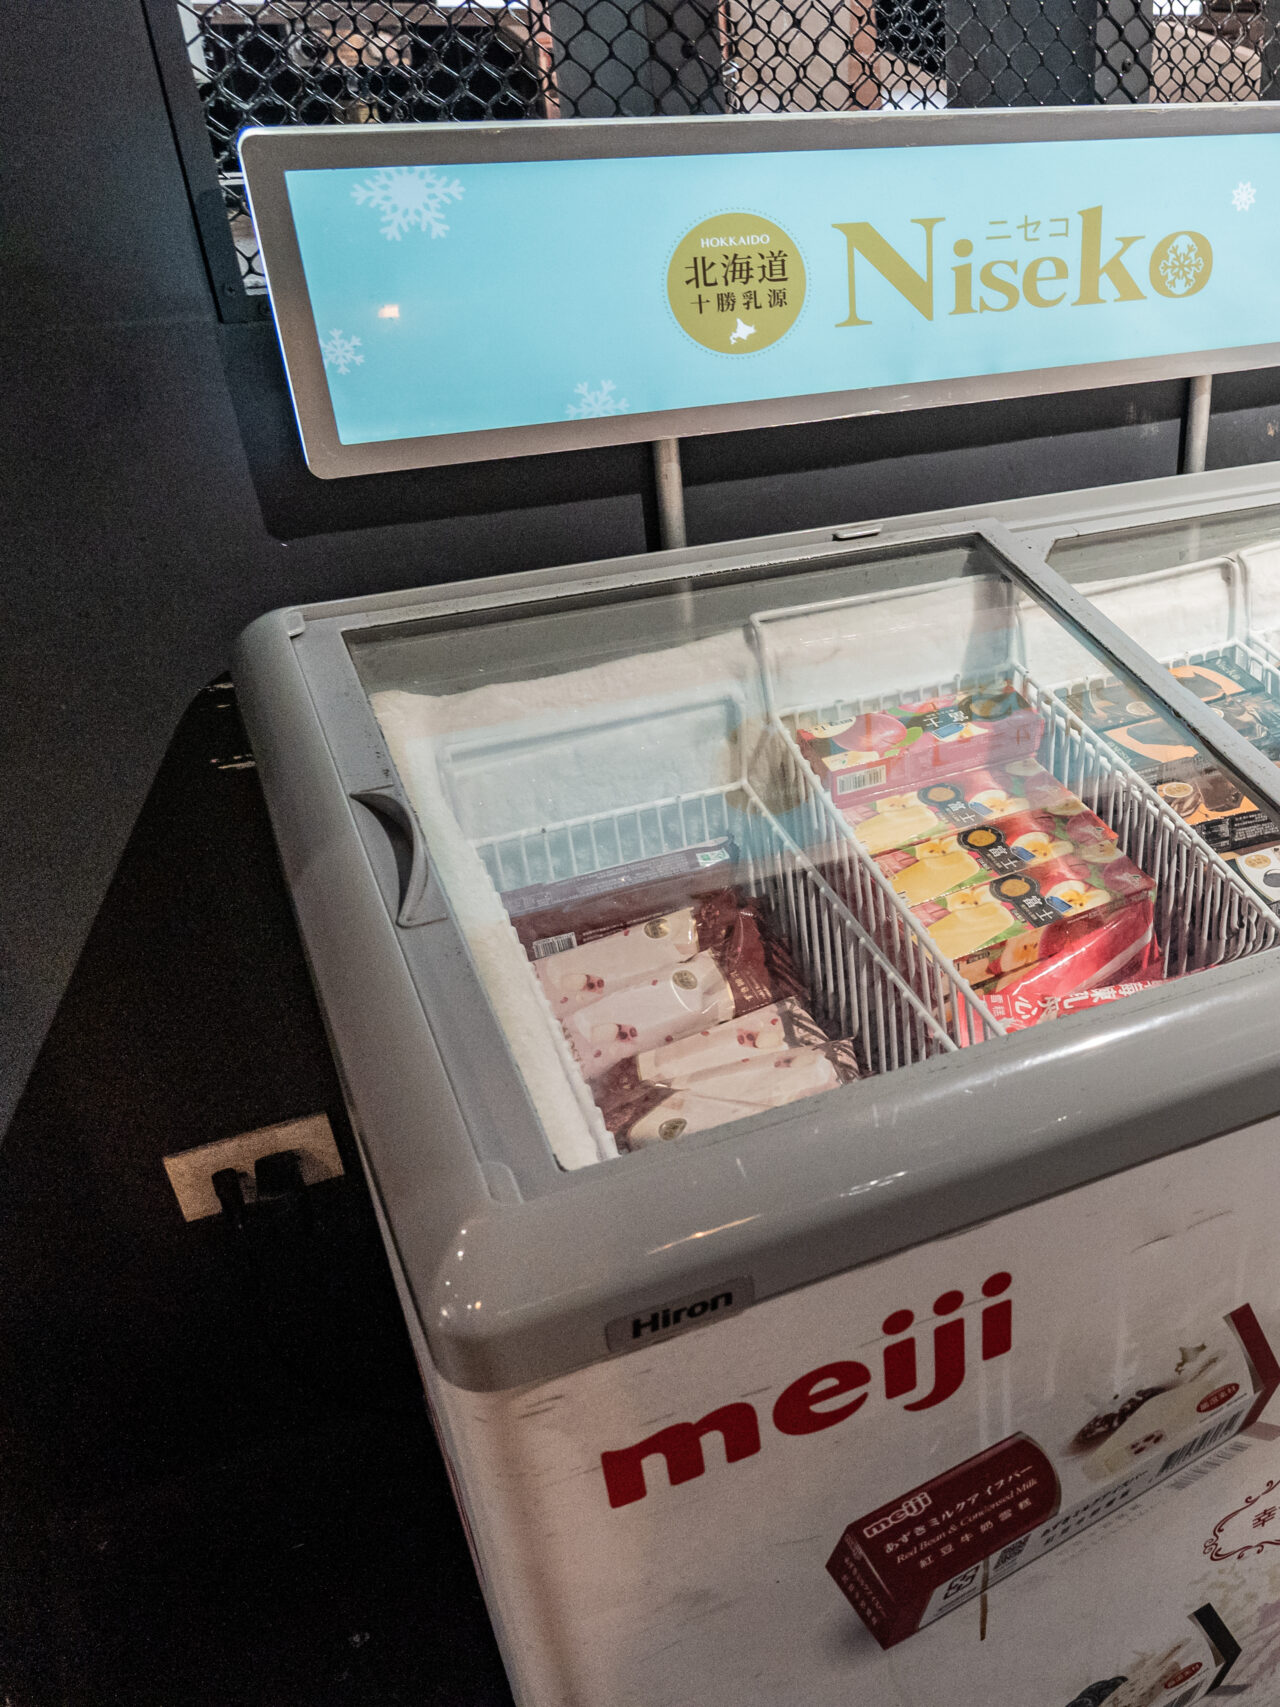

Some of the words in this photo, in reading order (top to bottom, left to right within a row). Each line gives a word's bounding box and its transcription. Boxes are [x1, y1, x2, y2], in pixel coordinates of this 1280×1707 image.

[700, 234, 770, 248] HOKKAIDO
[985, 214, 1071, 243] ニセコ
[684, 250, 788, 289] 北海道
[831, 204, 1214, 328] Niseko
[690, 288, 788, 314] 十勝乳源
[990, 845, 1018, 871] 富士
[1024, 895, 1055, 922] 富士
[632, 1291, 733, 1340] Hiron
[601, 1271, 1012, 1509] meiji
[863, 1491, 932, 1539] meiji
[896, 1547, 919, 1564] Red
[920, 1530, 948, 1552] Bean
[1016, 1477, 1040, 1496] Milk
